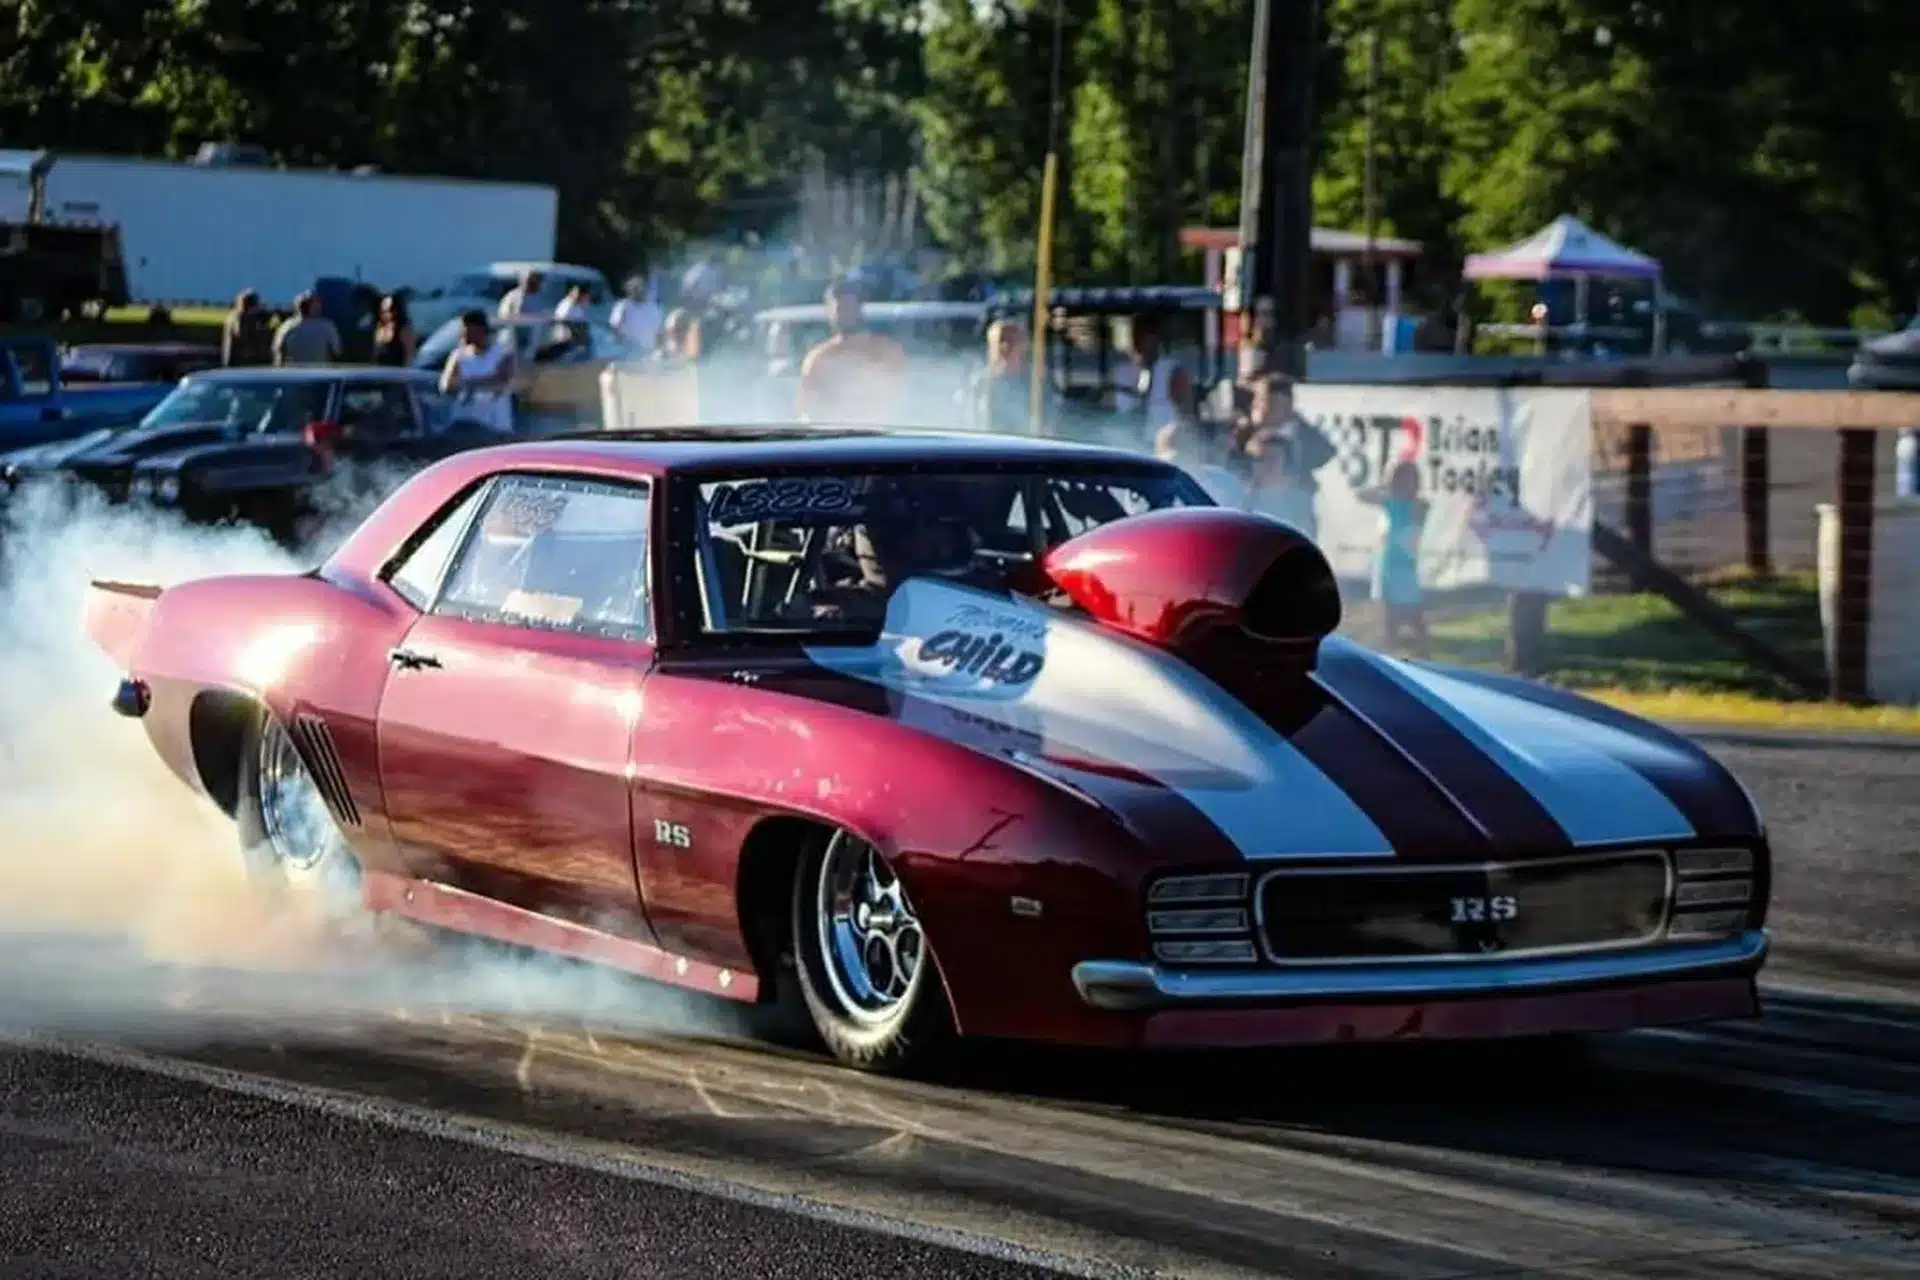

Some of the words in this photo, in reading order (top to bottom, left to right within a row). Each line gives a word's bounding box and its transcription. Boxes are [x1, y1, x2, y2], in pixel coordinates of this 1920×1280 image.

[1428, 414, 1500, 452] Brian
[1428, 457, 1520, 508] Tooley
[654, 818, 691, 849] RS
[1449, 895, 1518, 922] RS
